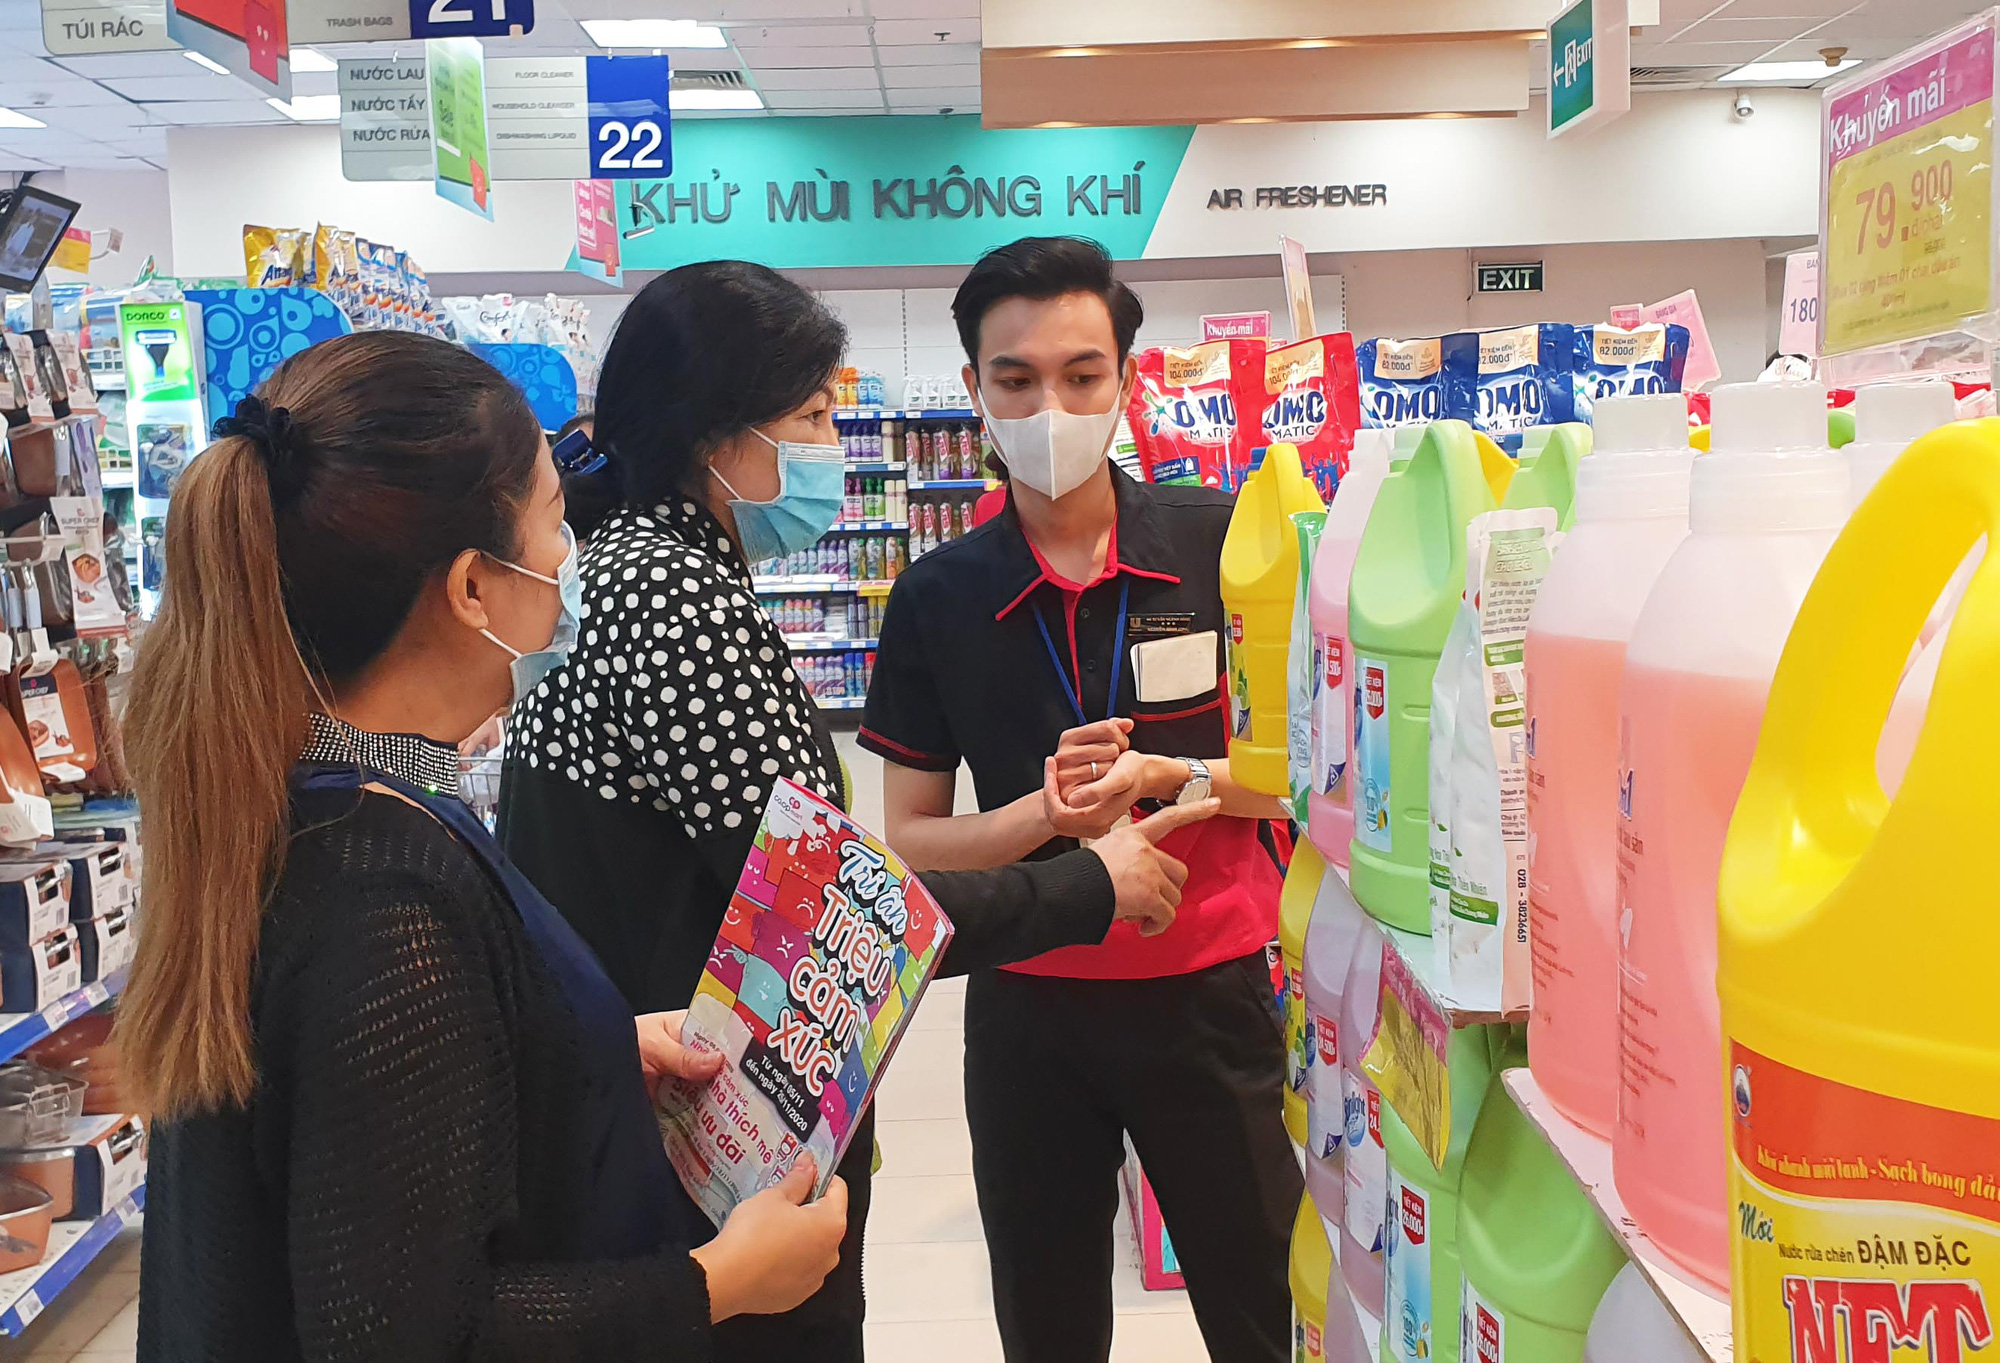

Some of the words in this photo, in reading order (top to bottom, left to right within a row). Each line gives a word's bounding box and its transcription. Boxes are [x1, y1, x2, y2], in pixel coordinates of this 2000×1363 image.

[62, 20, 95, 40] TÚI
[101, 18, 143, 38] RÁC
[326, 18, 361, 28] TRASH
[364, 16, 393, 26] BAGS
[1577, 37, 1592, 67] EXIT
[350, 66, 394, 81] NƯỚC
[397, 68, 425, 81] LAU
[351, 96, 395, 111] NƯỚC
[1830, 84, 1900, 154] Khuyến
[1907, 67, 1946, 121] mãi
[353, 126, 397, 142] NƯỚC
[599, 121, 663, 169] 22
[636, 167, 740, 225] KHỬ
[767, 167, 849, 222] MÙI
[873, 164, 1041, 220] KHÔNG
[1065, 161, 1144, 218] KHÍ
[1206, 187, 1243, 209] AIR
[1254, 184, 1387, 209] FRESHENER
[1911, 159, 1954, 212] 900
[1483, 269, 1535, 290] EXIT
[1206, 320, 1236, 338] Khuyến
[1238, 318, 1254, 335] mãi
[1372, 385, 1441, 422] OMO
[839, 839, 887, 900] Tri
[874, 885, 908, 937] ân
[1516, 869, 1528, 889] 028
[1516, 899, 1528, 944] 38236651
[814, 883, 891, 998] Triệu
[745, 1058, 760, 1076] đến
[758, 1073, 779, 1095] ngày
[716, 1132, 747, 1165] đãi
[725, 1100, 759, 1143] thích
[756, 1136, 774, 1165] mê
[1878, 1157, 1919, 1187] Sạch
[1921, 1161, 1966, 1199] bong
[1738, 1201, 1775, 1244] Mới
[1825, 1246, 1855, 1264] chén
[1856, 1233, 1909, 1270] ĐẬM
[1914, 1233, 1972, 1272] ĐẶC
